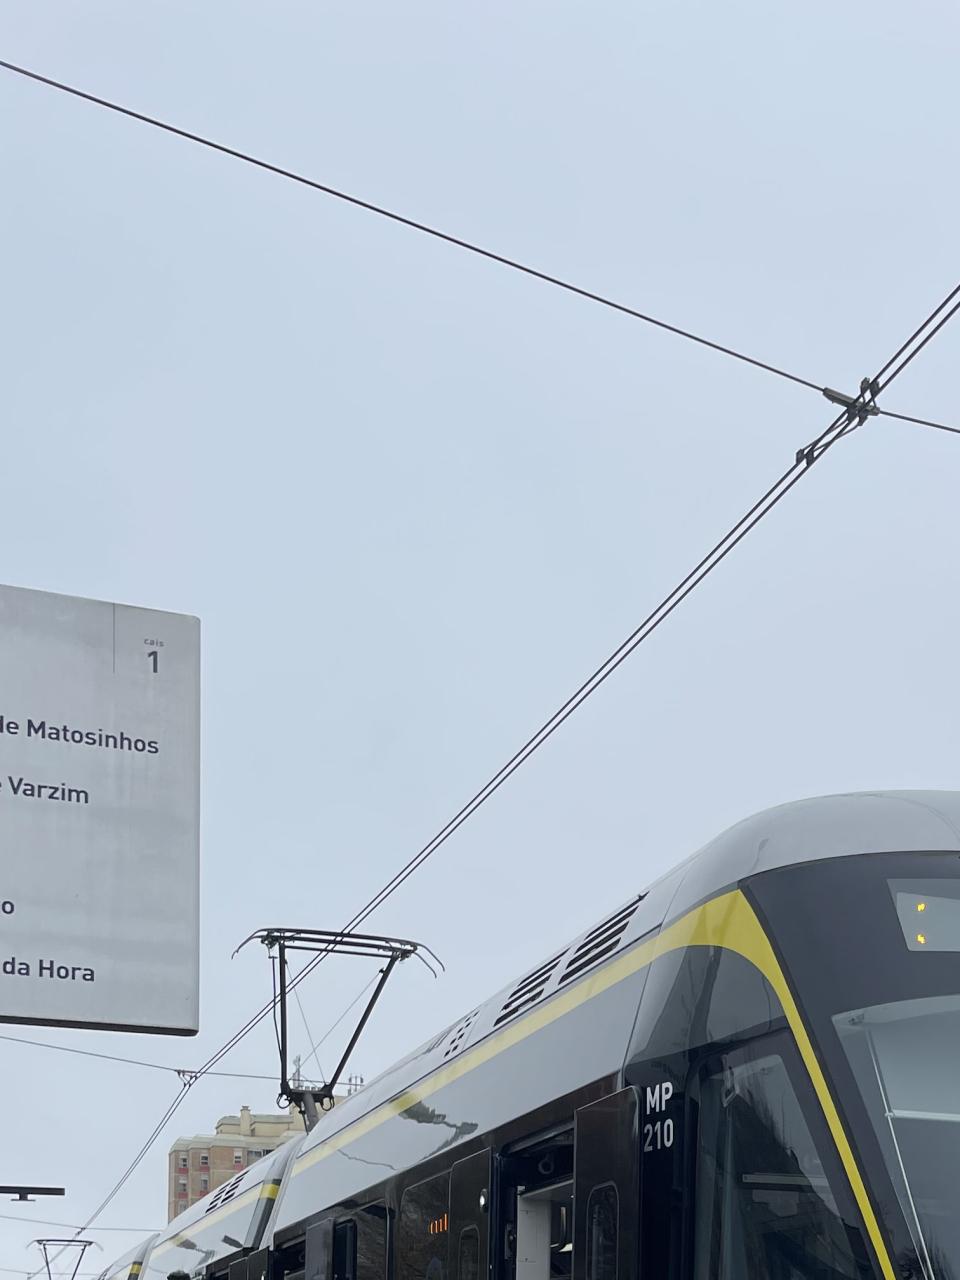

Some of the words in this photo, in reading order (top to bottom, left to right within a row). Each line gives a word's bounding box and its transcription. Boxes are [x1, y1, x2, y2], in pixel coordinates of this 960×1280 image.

[147, 650, 158, 673] 1
[27, 719, 159, 754] Matosinhos
[8, 776, 89, 804] Varzim
[3, 956, 31, 976] da
[39, 959, 95, 982] Hora
[646, 1081, 673, 1115] MP
[643, 1118, 673, 1152] 210
